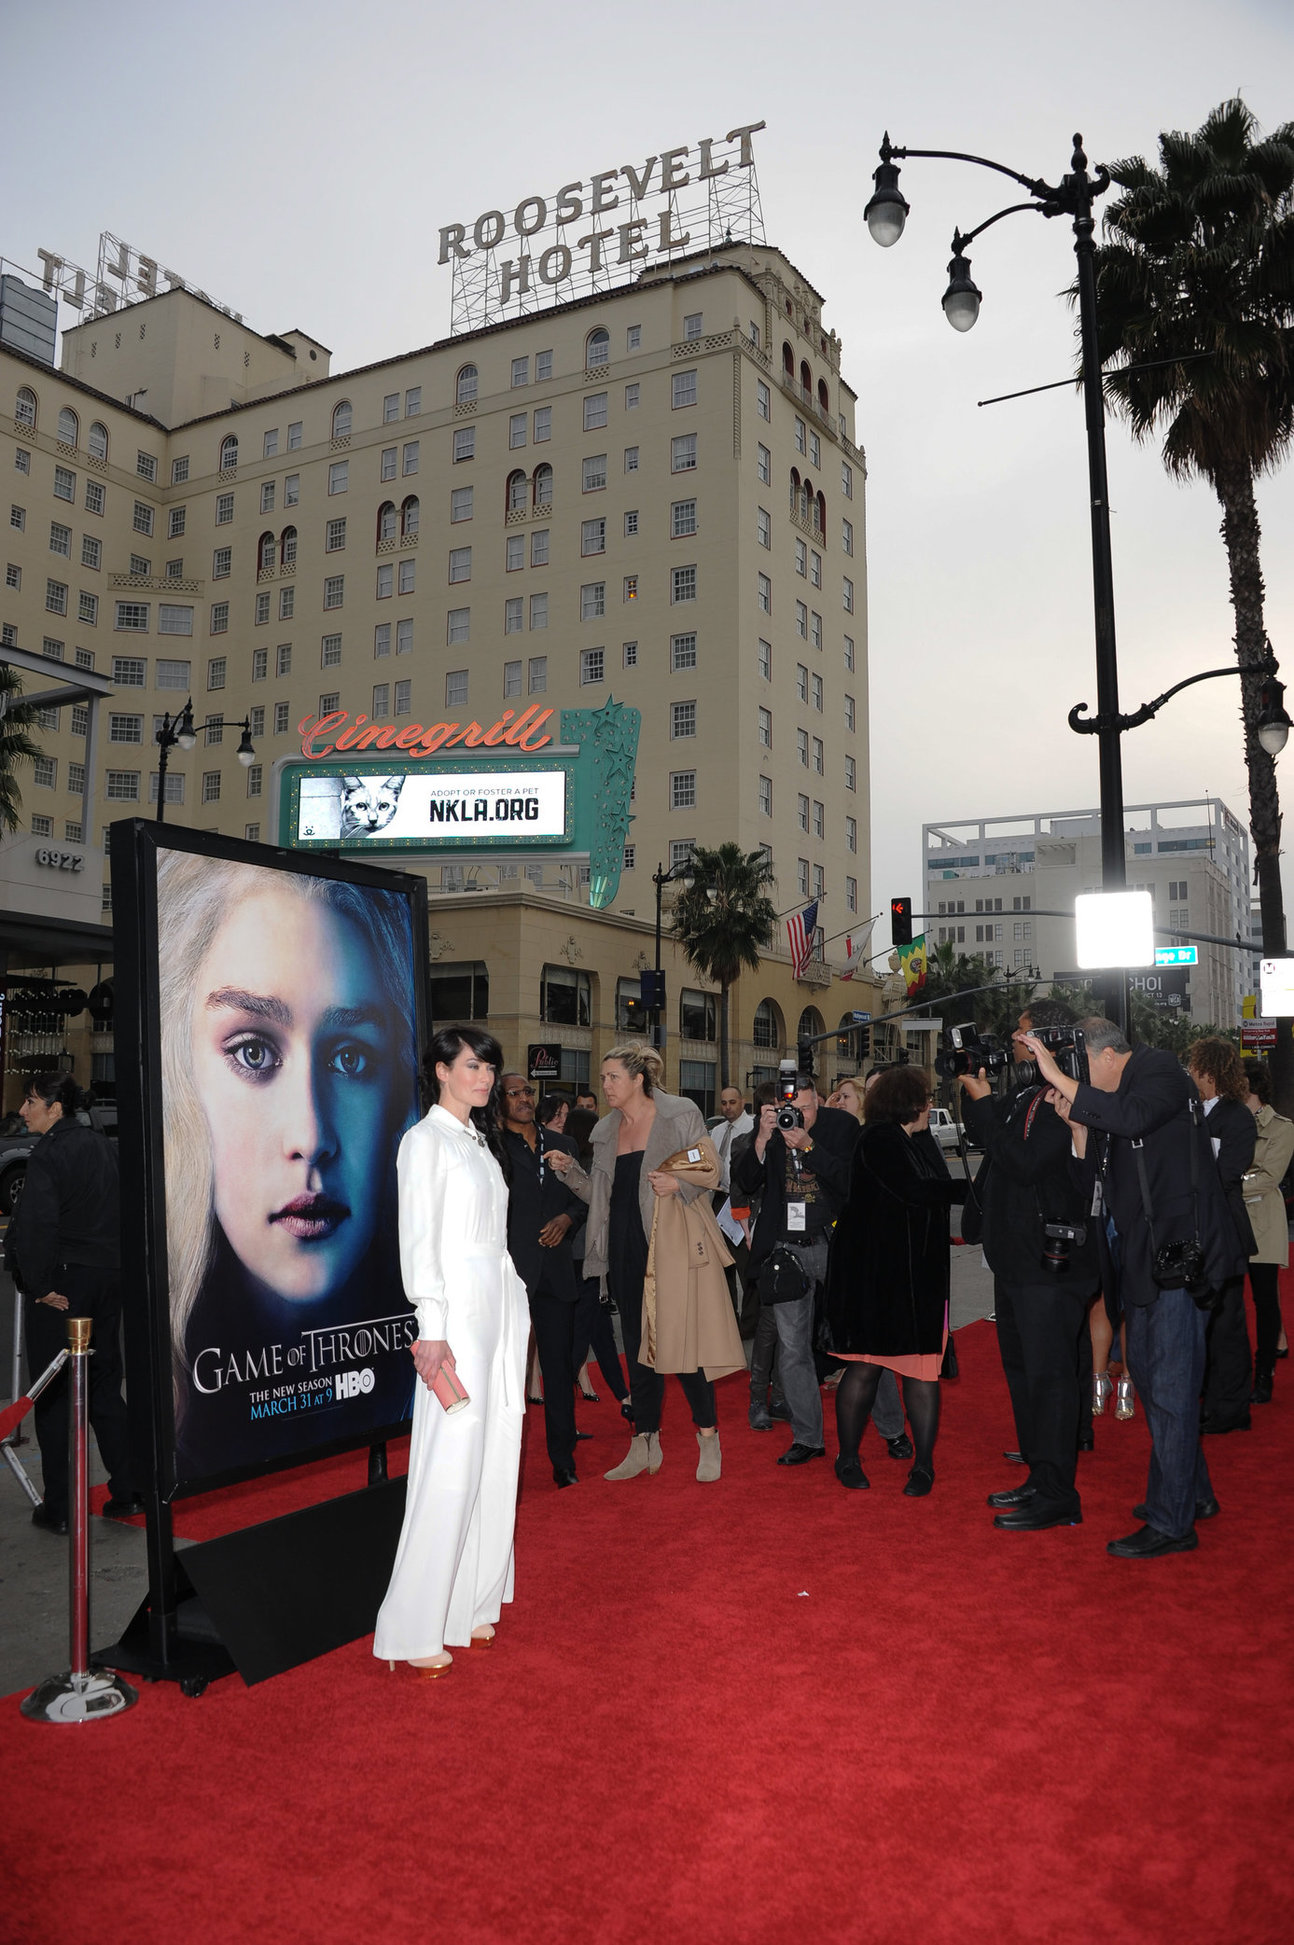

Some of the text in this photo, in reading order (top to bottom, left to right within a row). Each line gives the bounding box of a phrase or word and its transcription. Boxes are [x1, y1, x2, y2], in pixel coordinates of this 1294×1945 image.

[437, 120, 767, 265] ROOSEVELT
[500, 210, 690, 304] HOTEL
[297, 703, 555, 759] Cinegrill
[431, 789, 461, 797] ADOPT
[478, 788, 512, 796] FOSTER
[522, 787, 539, 795] PET
[430, 798, 539, 822] NKLA.ORG
[37, 848, 84, 871] 6922
[192, 1313, 416, 1394] GAME OF THRONES
[249, 1376, 333, 1404] THE NEW SEASON
[335, 1367, 375, 1400] HBO
[250, 1387, 334, 1421] MARCH 31 AT 9
